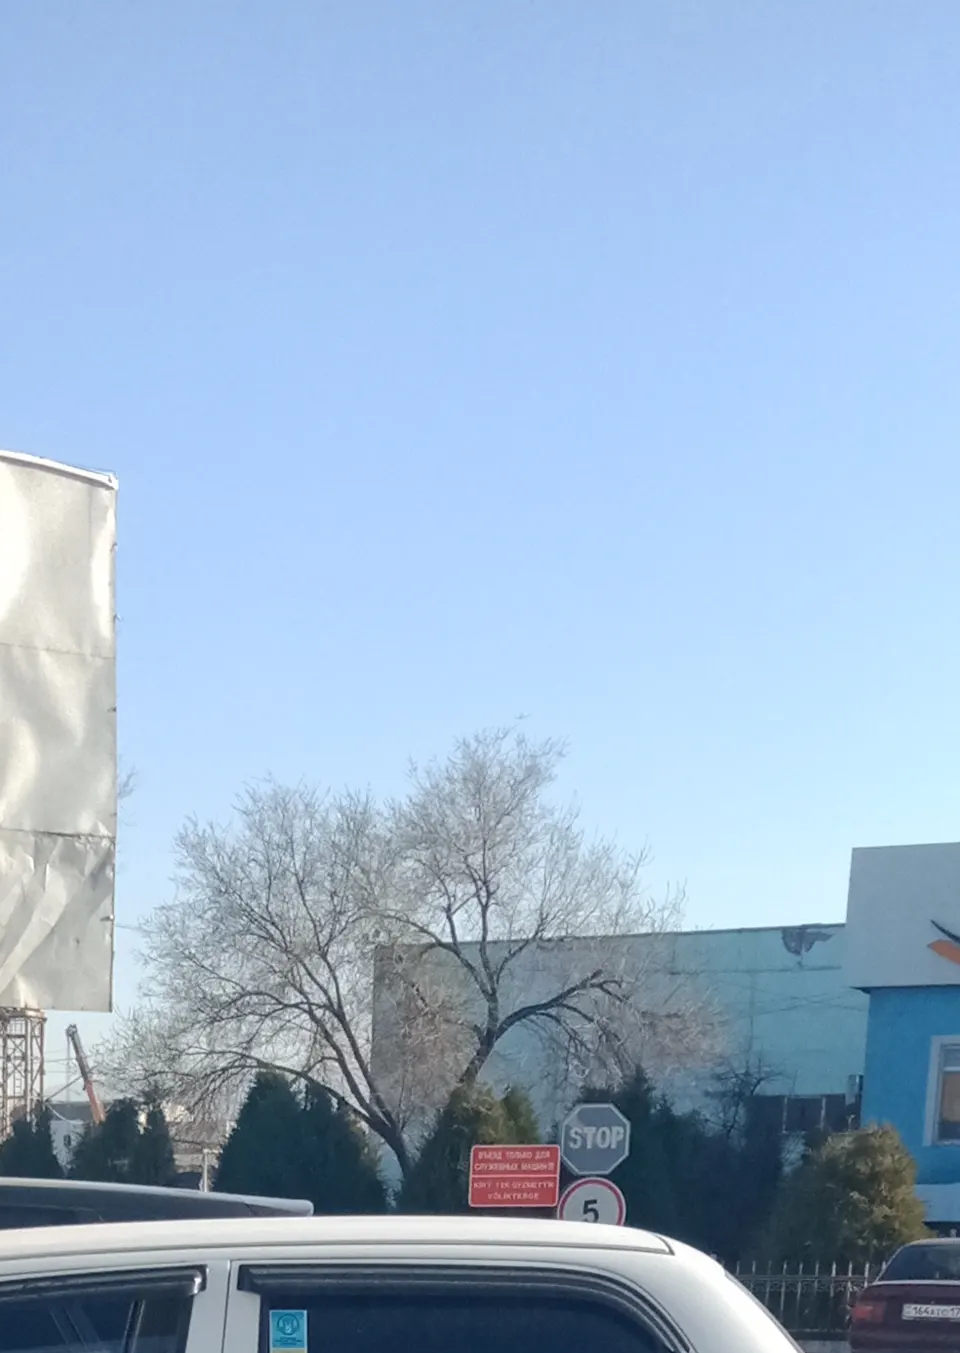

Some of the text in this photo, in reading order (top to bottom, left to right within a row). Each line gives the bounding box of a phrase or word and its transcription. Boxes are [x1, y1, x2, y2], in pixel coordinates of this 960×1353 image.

[567, 1126, 624, 1149] STOP
[505, 1151, 533, 1160] ТОЛЬКО
[535, 1150, 551, 1160] ДЛЯ
[583, 1199, 599, 1223] 5
